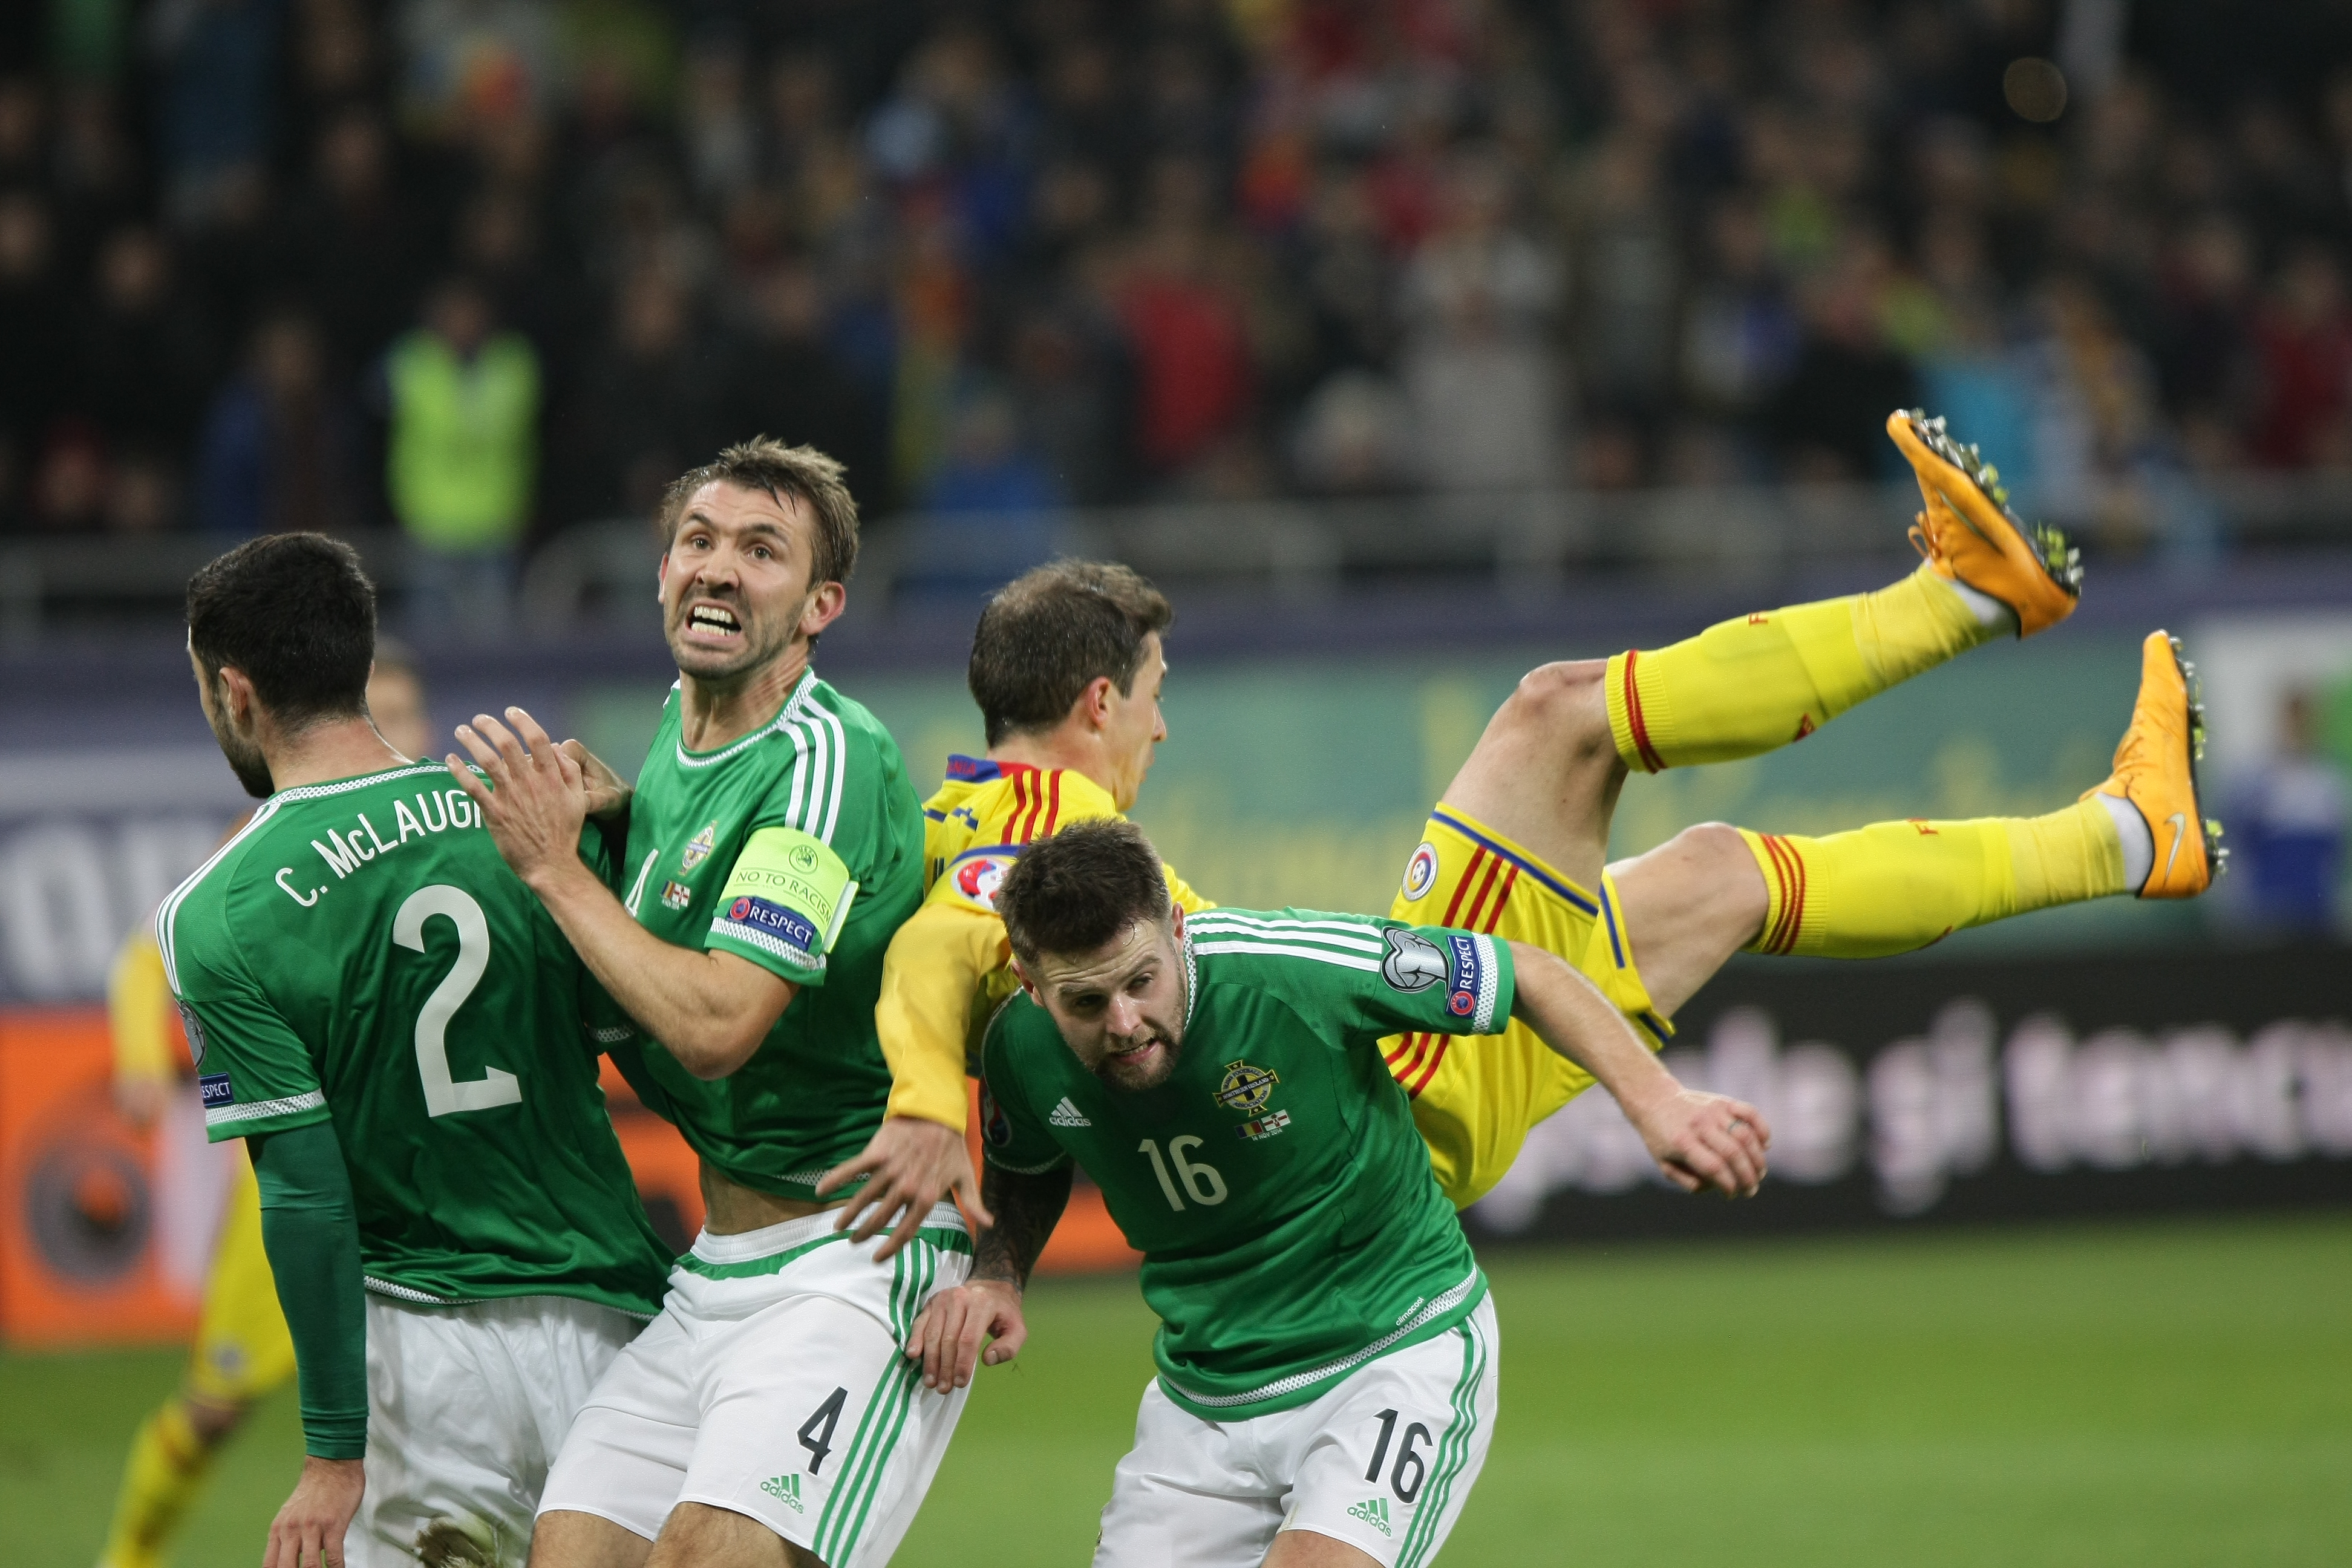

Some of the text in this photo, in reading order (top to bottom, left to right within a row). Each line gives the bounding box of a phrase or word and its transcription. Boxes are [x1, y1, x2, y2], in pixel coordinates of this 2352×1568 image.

[275, 867, 328, 907] C.
[736, 871, 760, 882] NO
[765, 872, 786, 886] TO
[749, 906, 812, 944] RESPECT
[1455, 936, 1474, 989] RESPECT
[392, 884, 523, 1118] 2
[201, 1082, 230, 1099] ESPECT
[1222, 1077, 1270, 1100] NORTHERN IRELAND
[1048, 1116, 1092, 1126] adidas
[1137, 1134, 1228, 1212] 16
[1396, 1296, 1425, 1326] climacool
[796, 1385, 848, 1475] 4
[1364, 1408, 1434, 1504] 16
[760, 1481, 805, 1514] adidas
[1346, 1506, 1392, 1538] adidas
